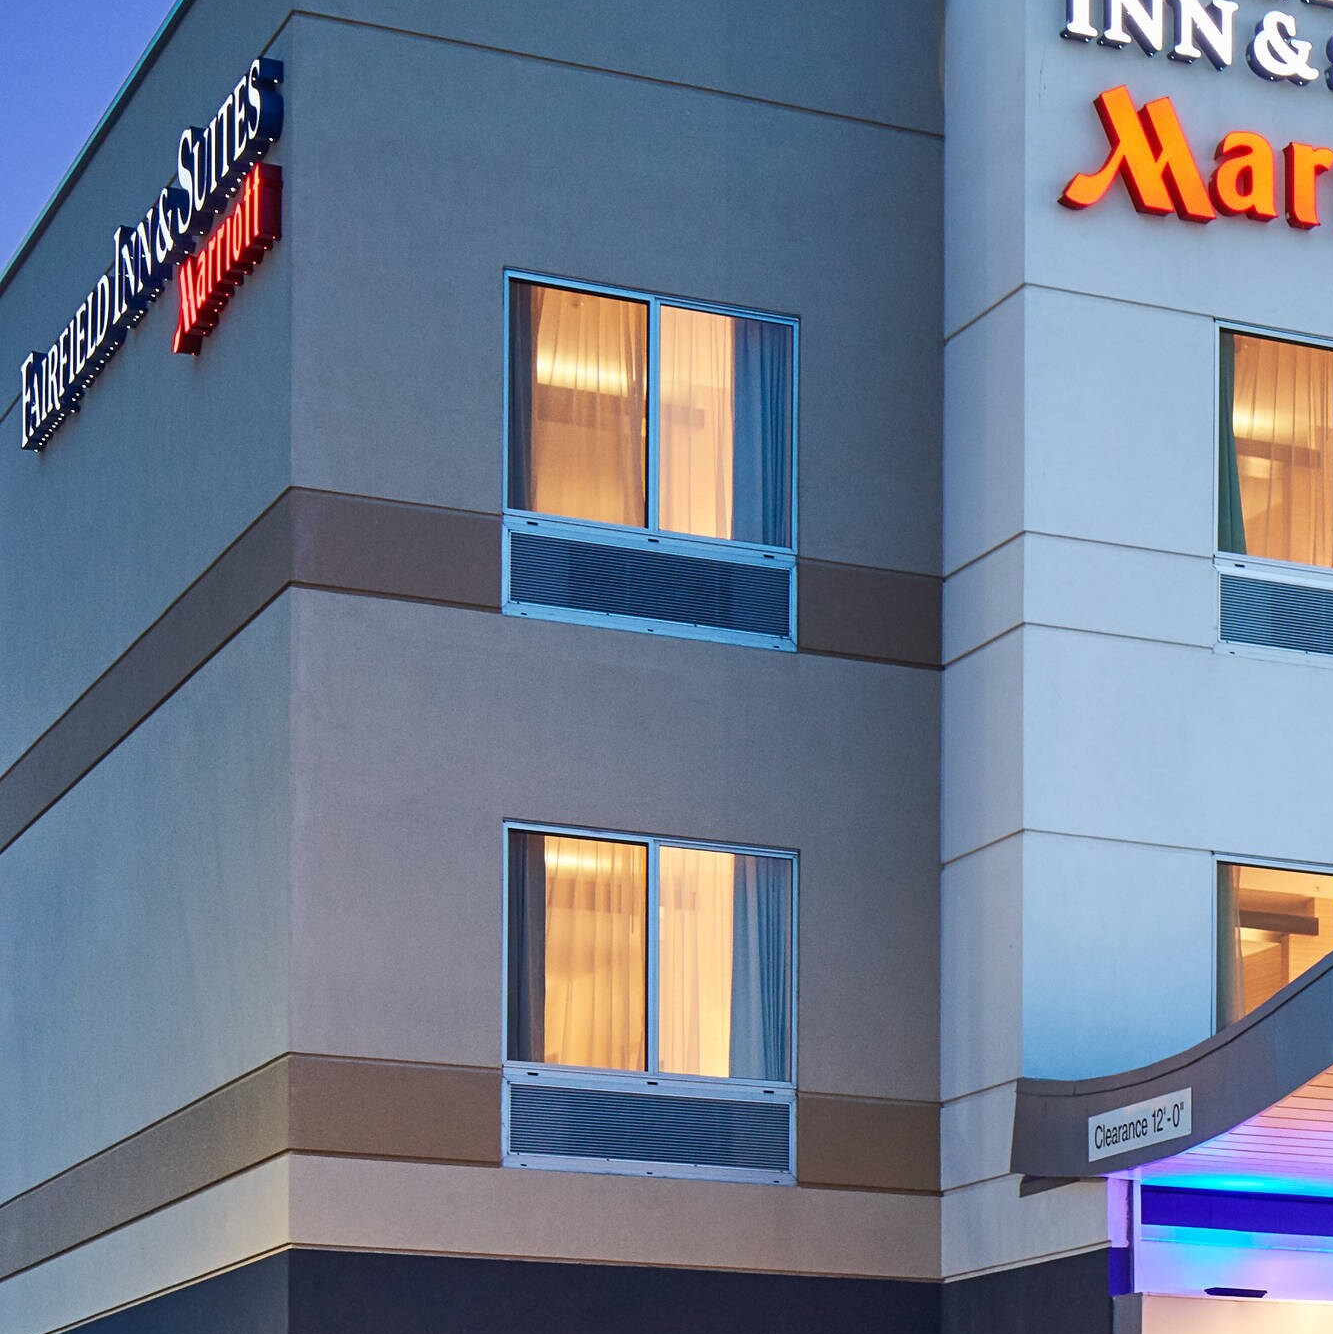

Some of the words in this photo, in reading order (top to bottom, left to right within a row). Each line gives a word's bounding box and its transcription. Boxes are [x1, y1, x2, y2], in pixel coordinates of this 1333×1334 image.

[1246, 10, 1320, 84] &
[20, 275, 110, 449] FAIRFIELD
[113, 208, 154, 325] INN
[156, 187, 174, 264] &
[178, 59, 264, 234] SUITES
[172, 163, 264, 354] Marriott
[1094, 1117, 1148, 1150] Clearance
